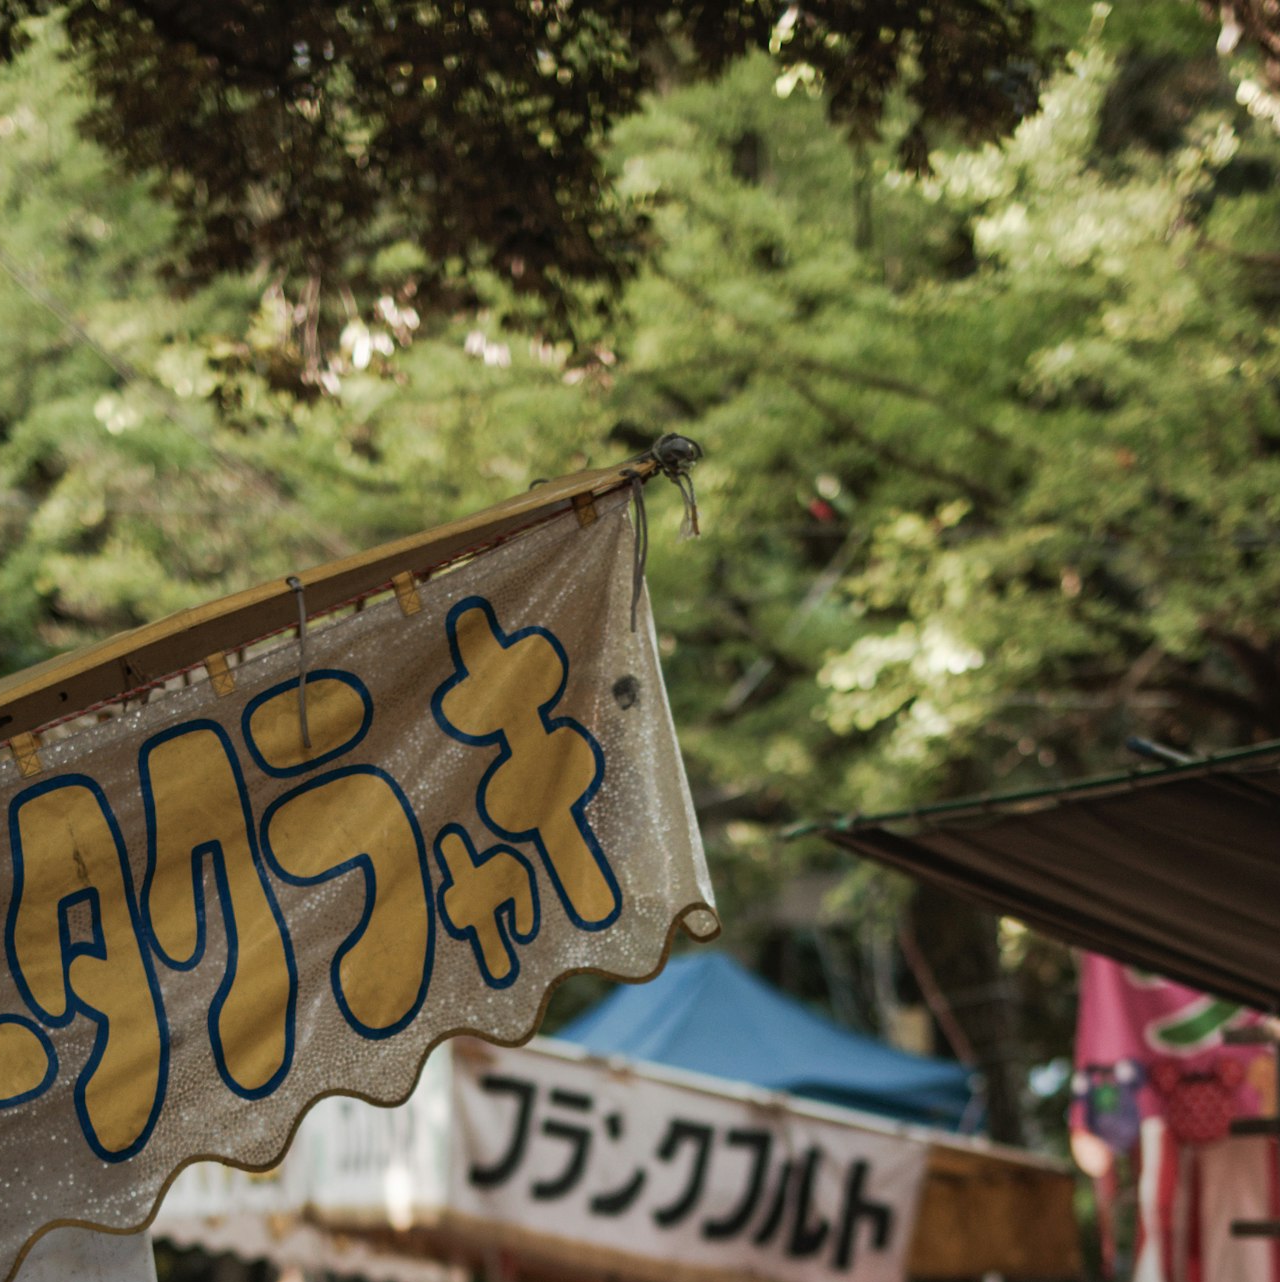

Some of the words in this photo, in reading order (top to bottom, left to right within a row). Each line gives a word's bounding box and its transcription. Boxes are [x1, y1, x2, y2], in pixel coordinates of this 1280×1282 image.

[468, 1074, 894, 1272] フランクフルト
